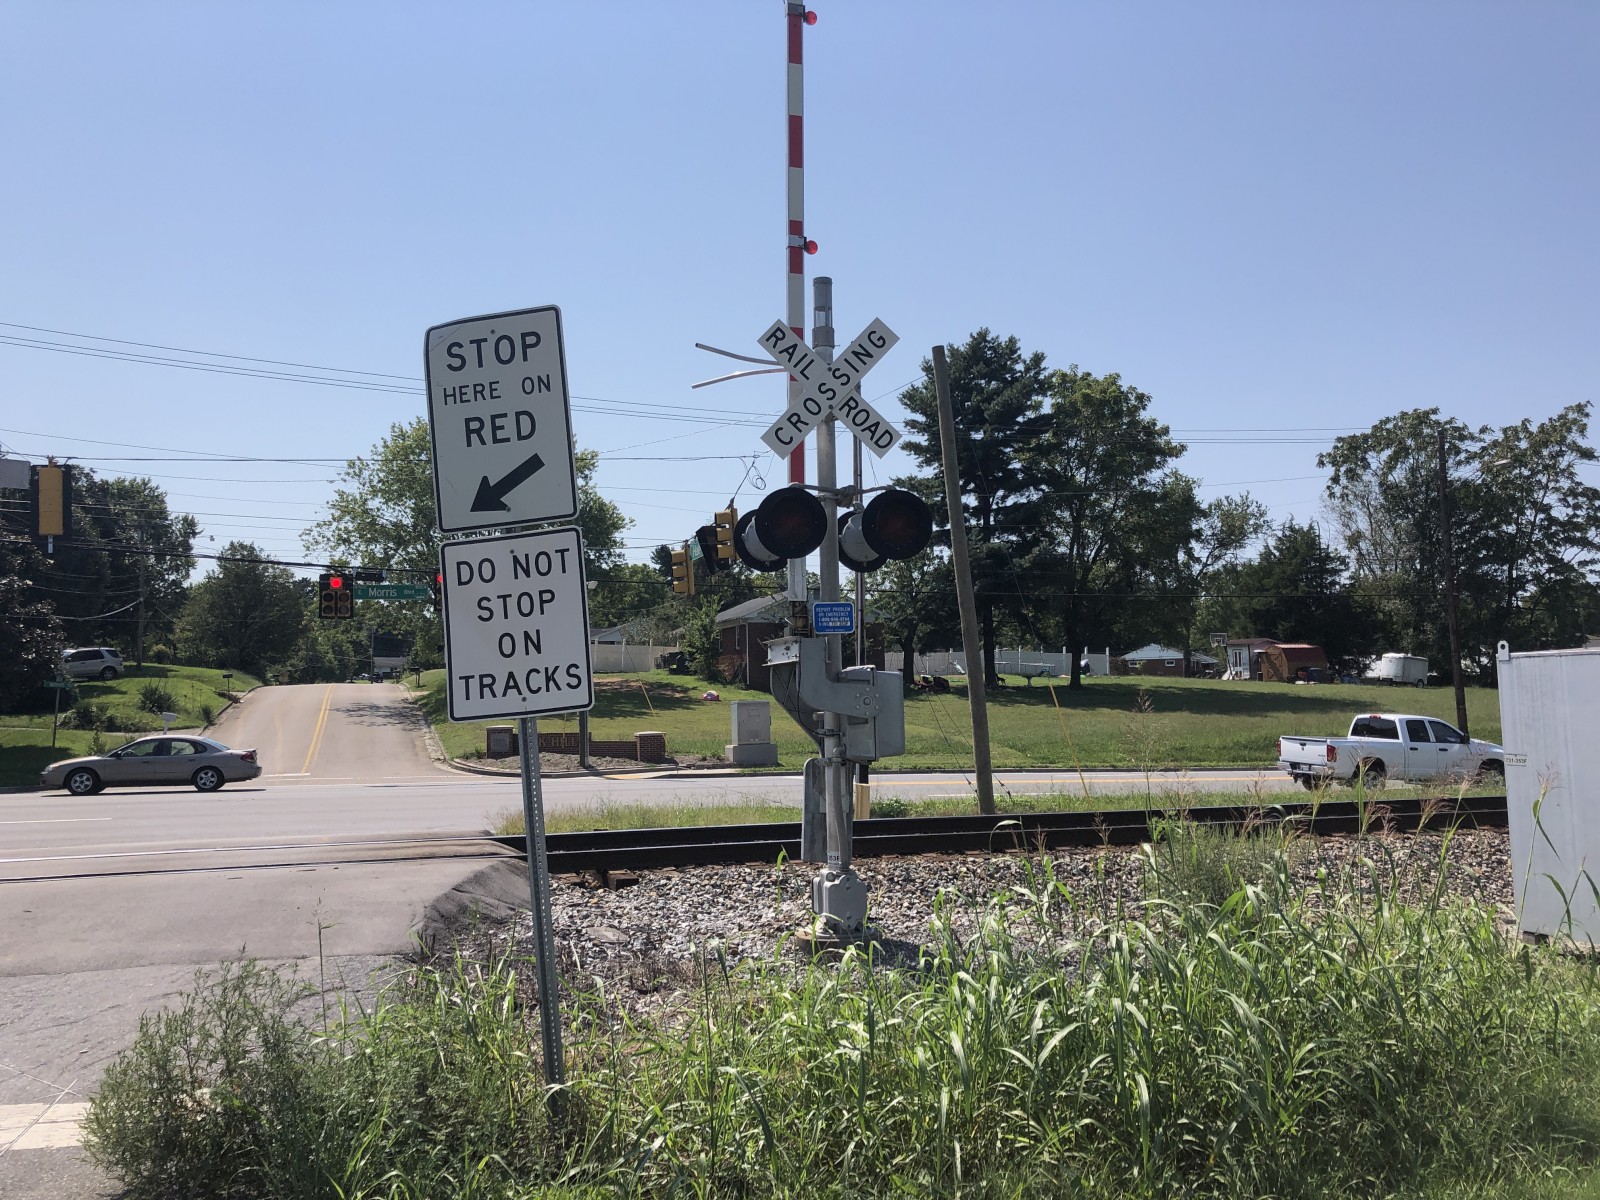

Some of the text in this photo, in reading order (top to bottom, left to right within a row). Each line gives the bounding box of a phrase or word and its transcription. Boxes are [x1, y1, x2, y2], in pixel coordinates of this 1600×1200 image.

[446, 331, 541, 372] STOP
[443, 374, 551, 406] HERE ON
[765, 326, 894, 449] RAIL ROAD
[774, 330, 887, 446] CROSSING
[464, 410, 537, 447] RED
[456, 548, 570, 586] DO NOT
[368, 587, 397, 597] Morris
[477, 589, 556, 622] STOP
[498, 629, 542, 658] ON
[459, 663, 582, 700] TRACKS
[552, 737, 578, 747] HILL
